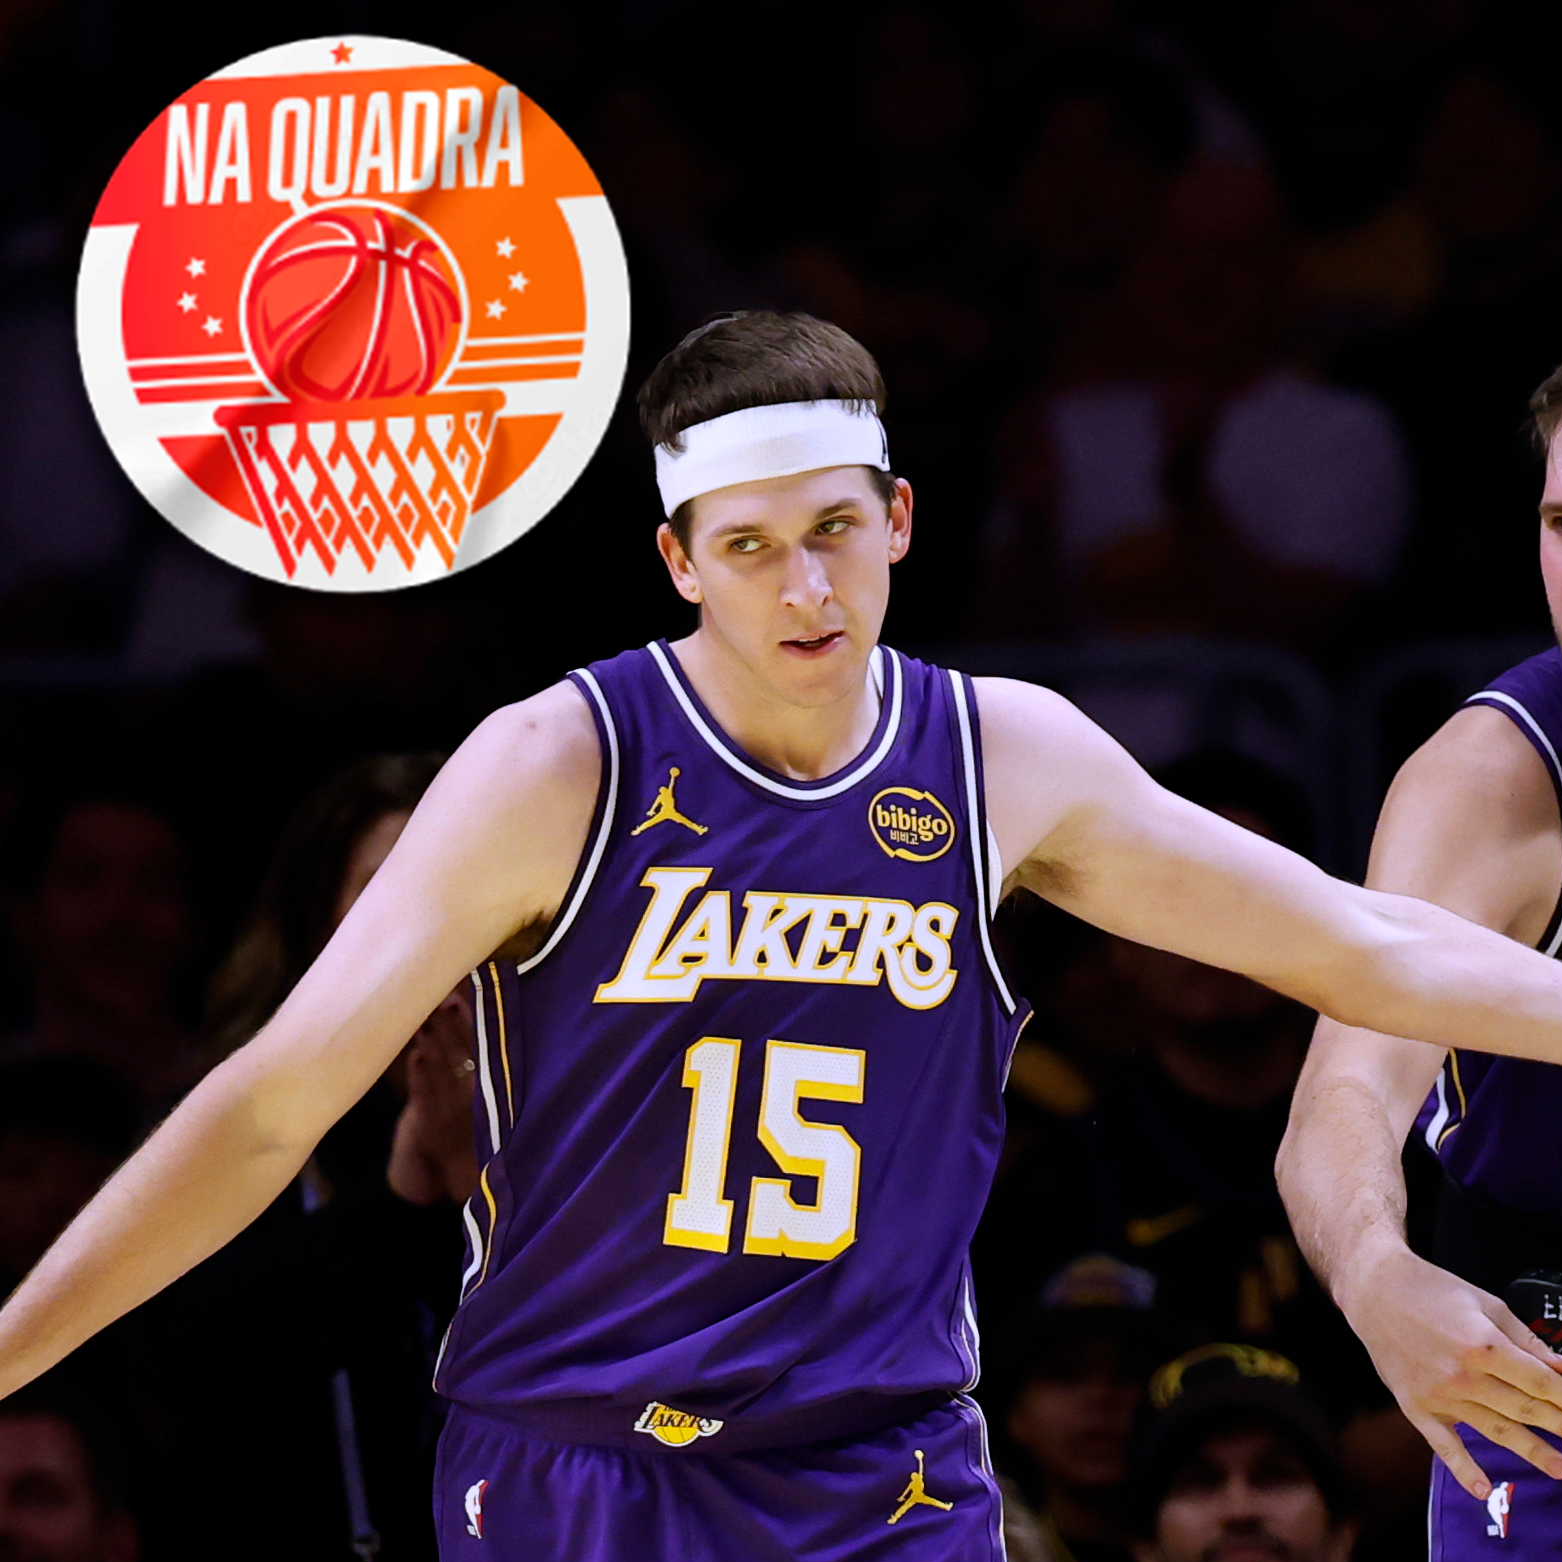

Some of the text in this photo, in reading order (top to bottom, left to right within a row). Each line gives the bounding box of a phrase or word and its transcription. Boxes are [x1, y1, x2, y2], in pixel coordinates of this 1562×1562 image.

[876, 804, 948, 842] bibigo
[593, 866, 960, 1010] LAKERS
[663, 1036, 867, 1261] 15
